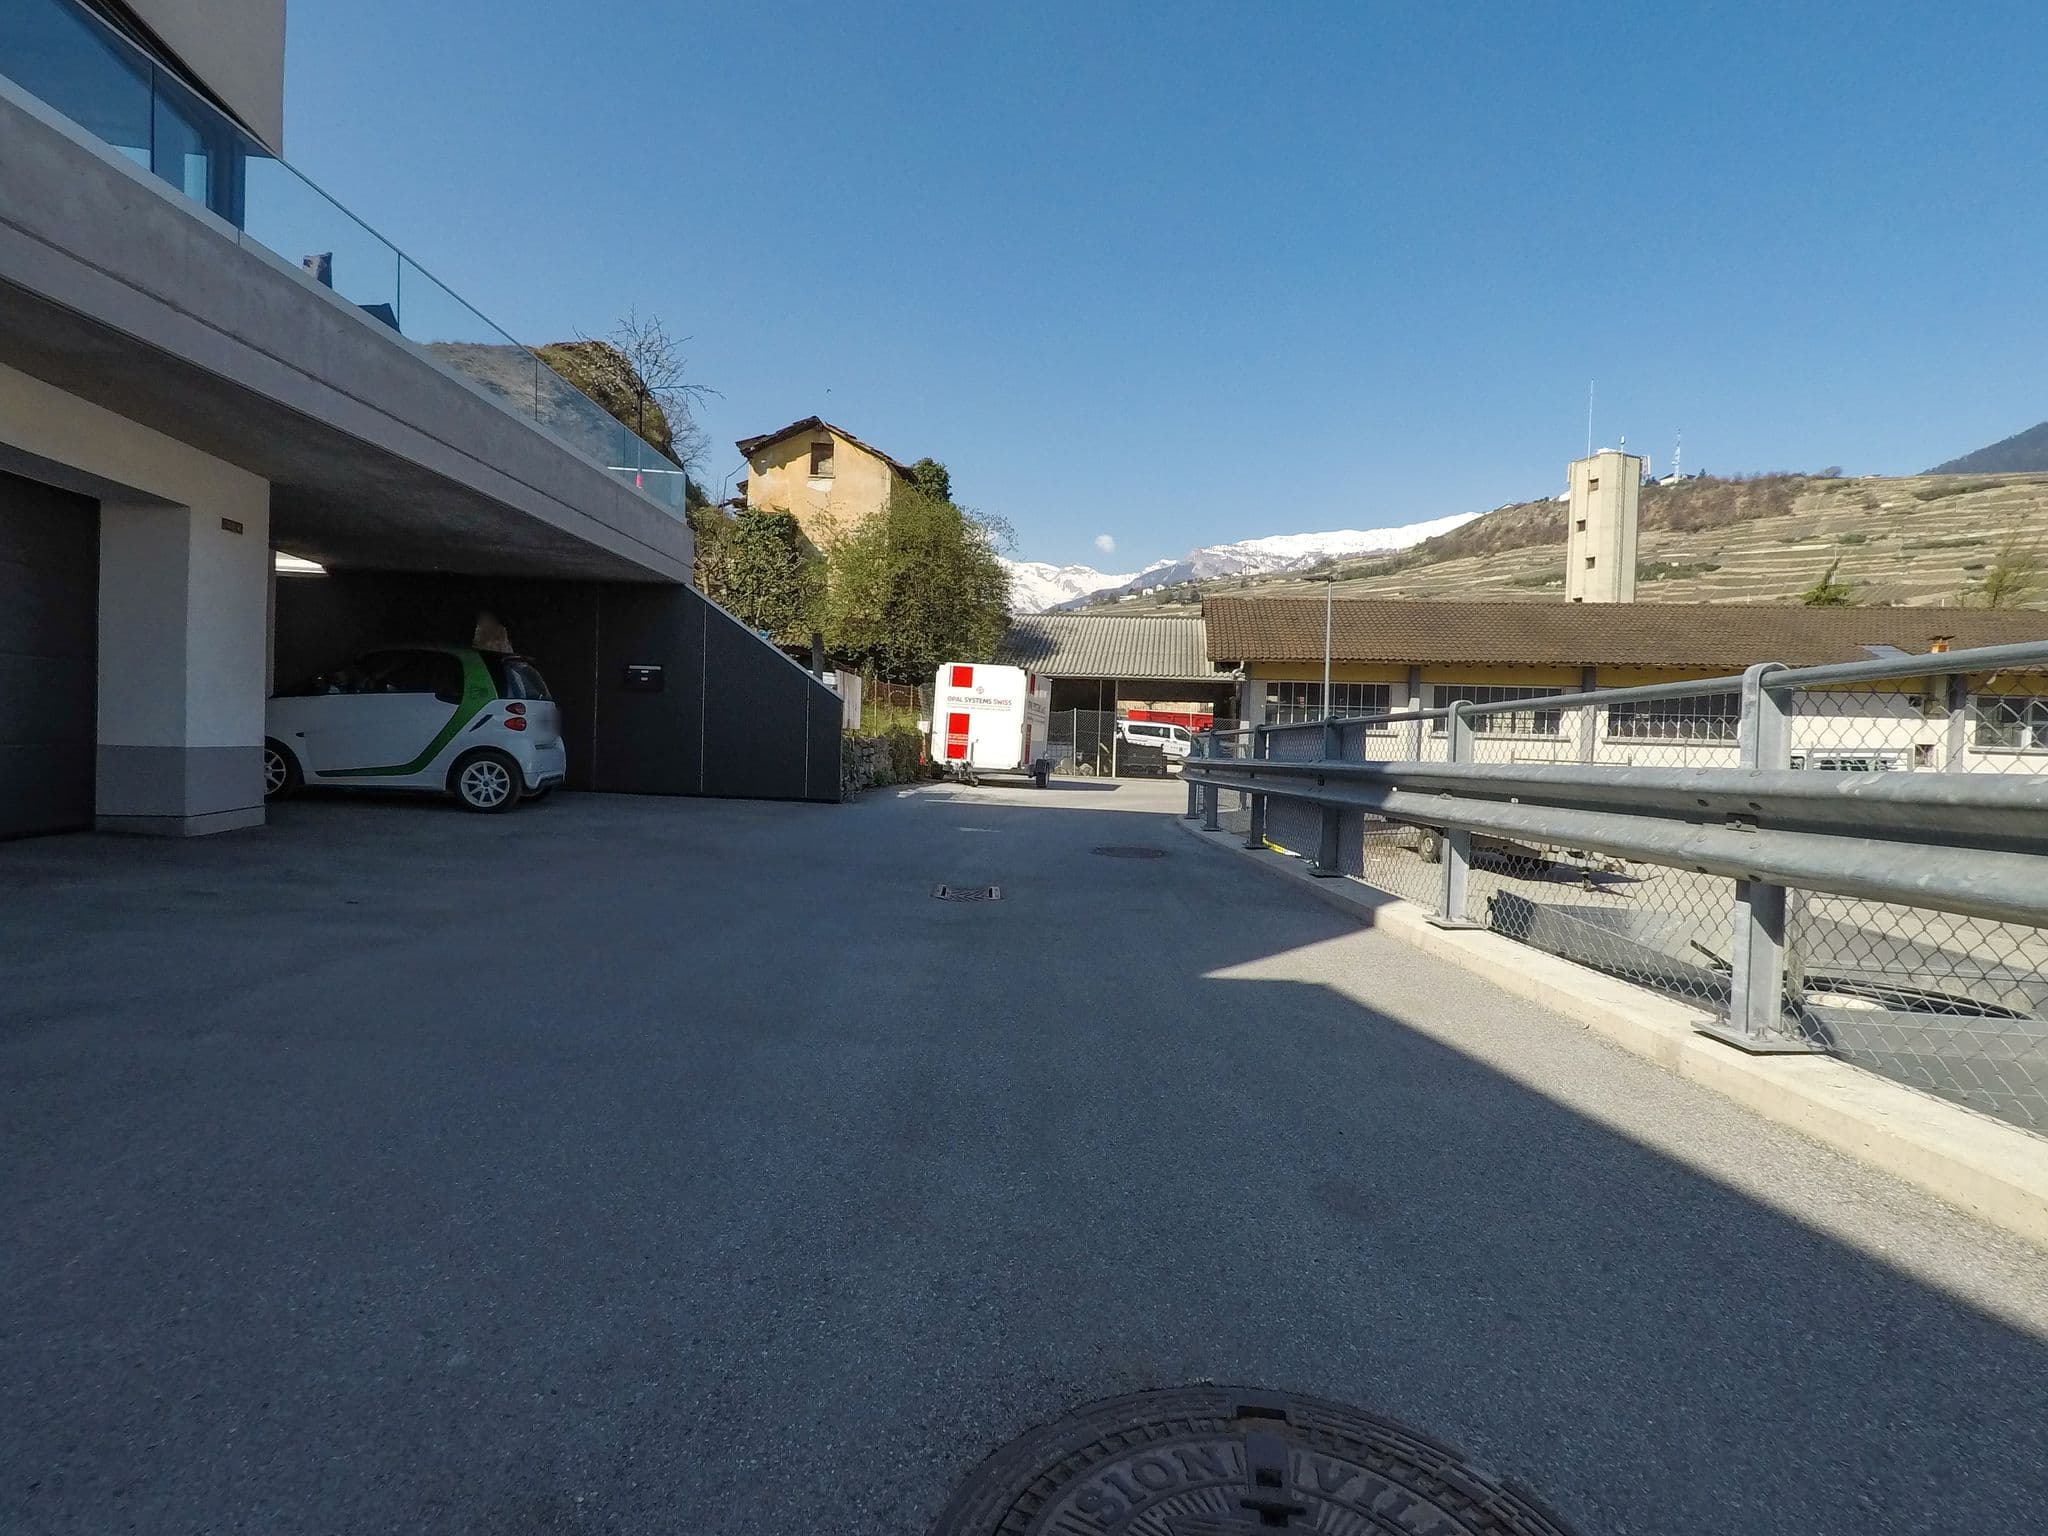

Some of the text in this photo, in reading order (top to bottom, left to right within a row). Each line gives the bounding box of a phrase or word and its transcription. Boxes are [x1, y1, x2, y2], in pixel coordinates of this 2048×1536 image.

[964, 697, 992, 705] SYSTEMS
[993, 698, 1012, 706] SWISS
[1076, 1445, 1230, 1520] SION
